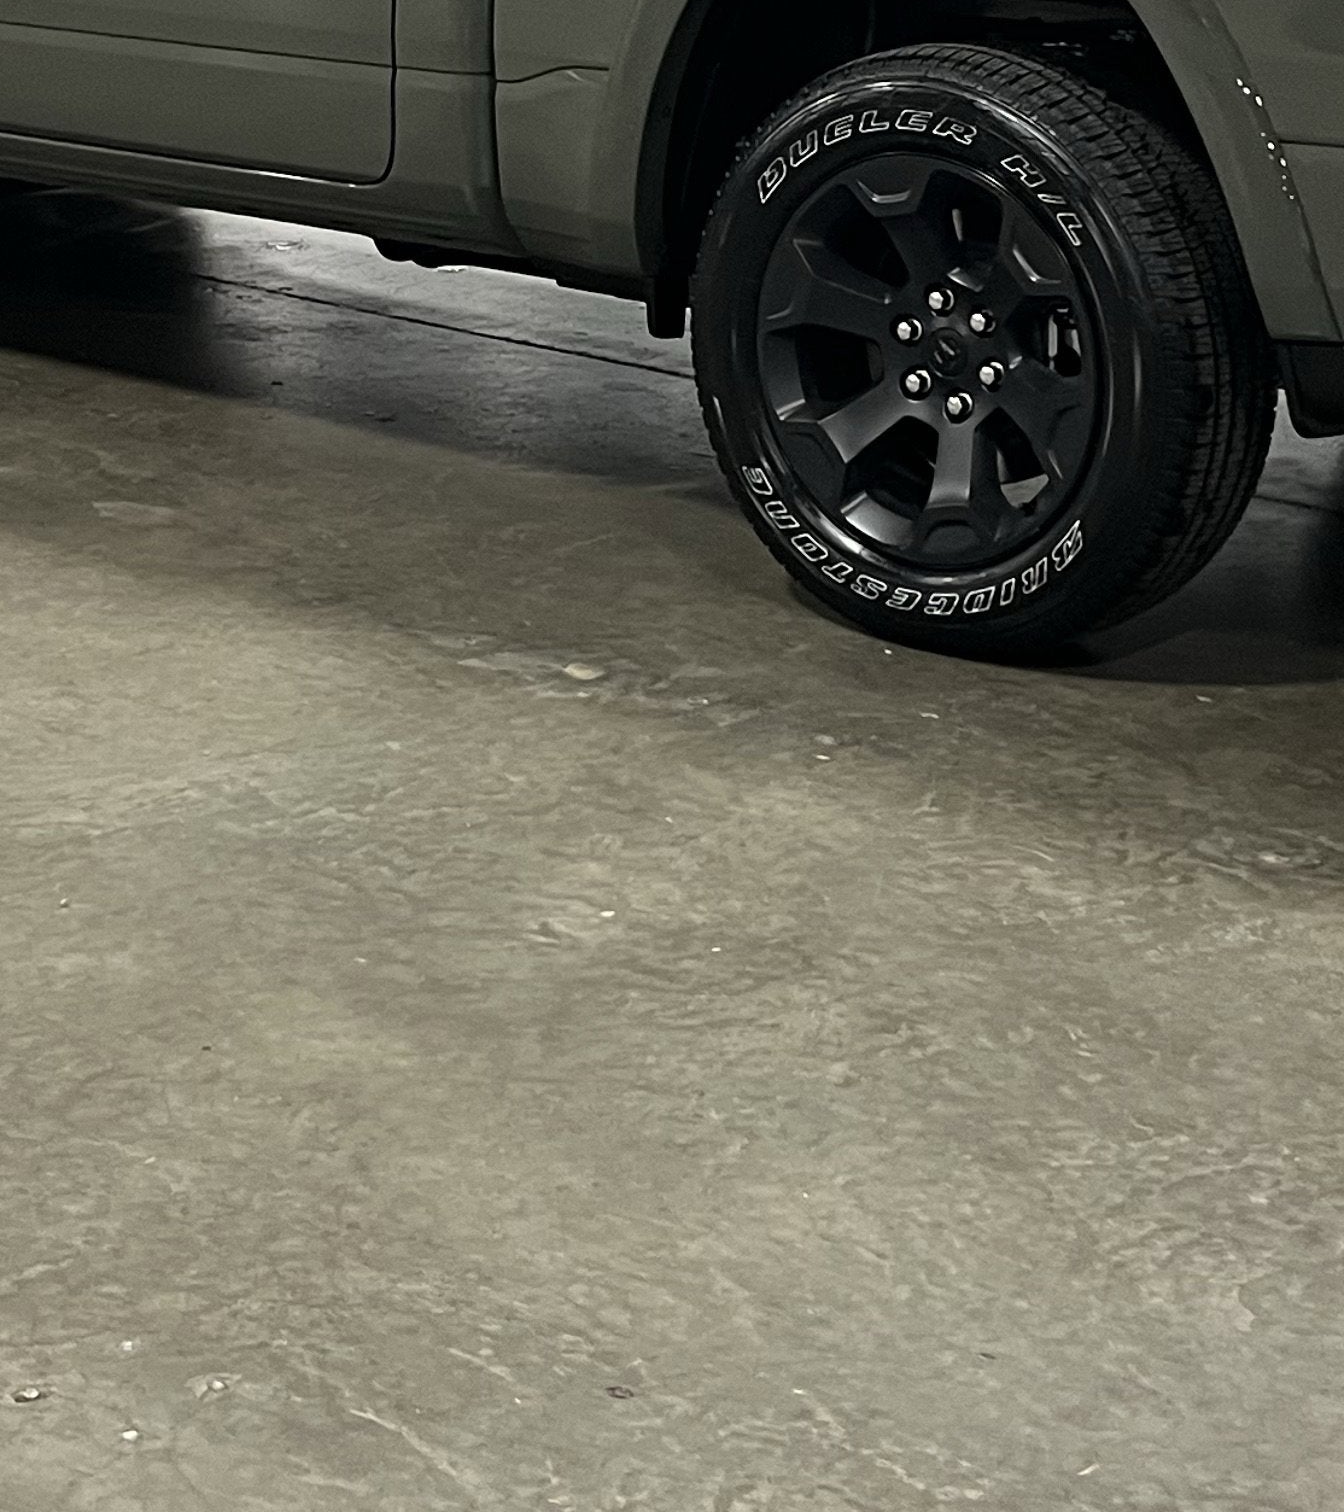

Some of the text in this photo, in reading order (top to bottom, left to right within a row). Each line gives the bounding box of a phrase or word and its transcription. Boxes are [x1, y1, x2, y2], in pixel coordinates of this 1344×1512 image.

[757, 109, 1083, 246] DUELER H/L
[742, 465, 1083, 616] BRIDGESTONE
